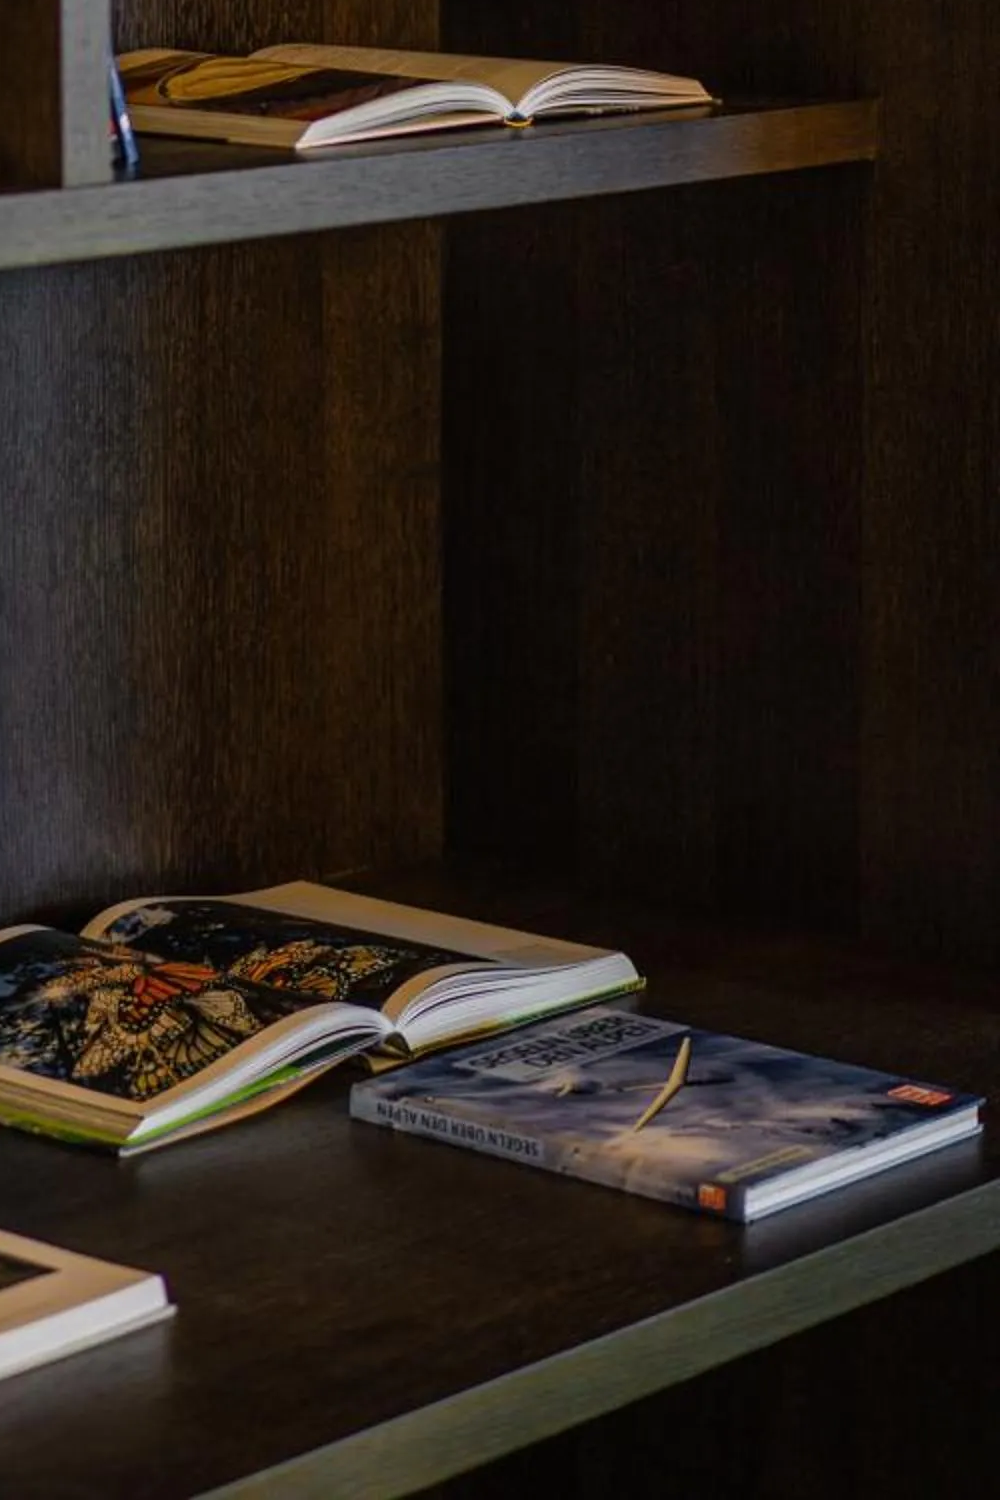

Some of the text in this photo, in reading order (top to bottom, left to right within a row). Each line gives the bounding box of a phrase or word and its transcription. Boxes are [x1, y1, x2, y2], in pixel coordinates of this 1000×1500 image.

[523, 1046, 588, 1070] DEN
[376, 1101, 418, 1125] ALPEN
[421, 1112, 448, 1133] DEN
[487, 1131, 539, 1157] SEGELN
